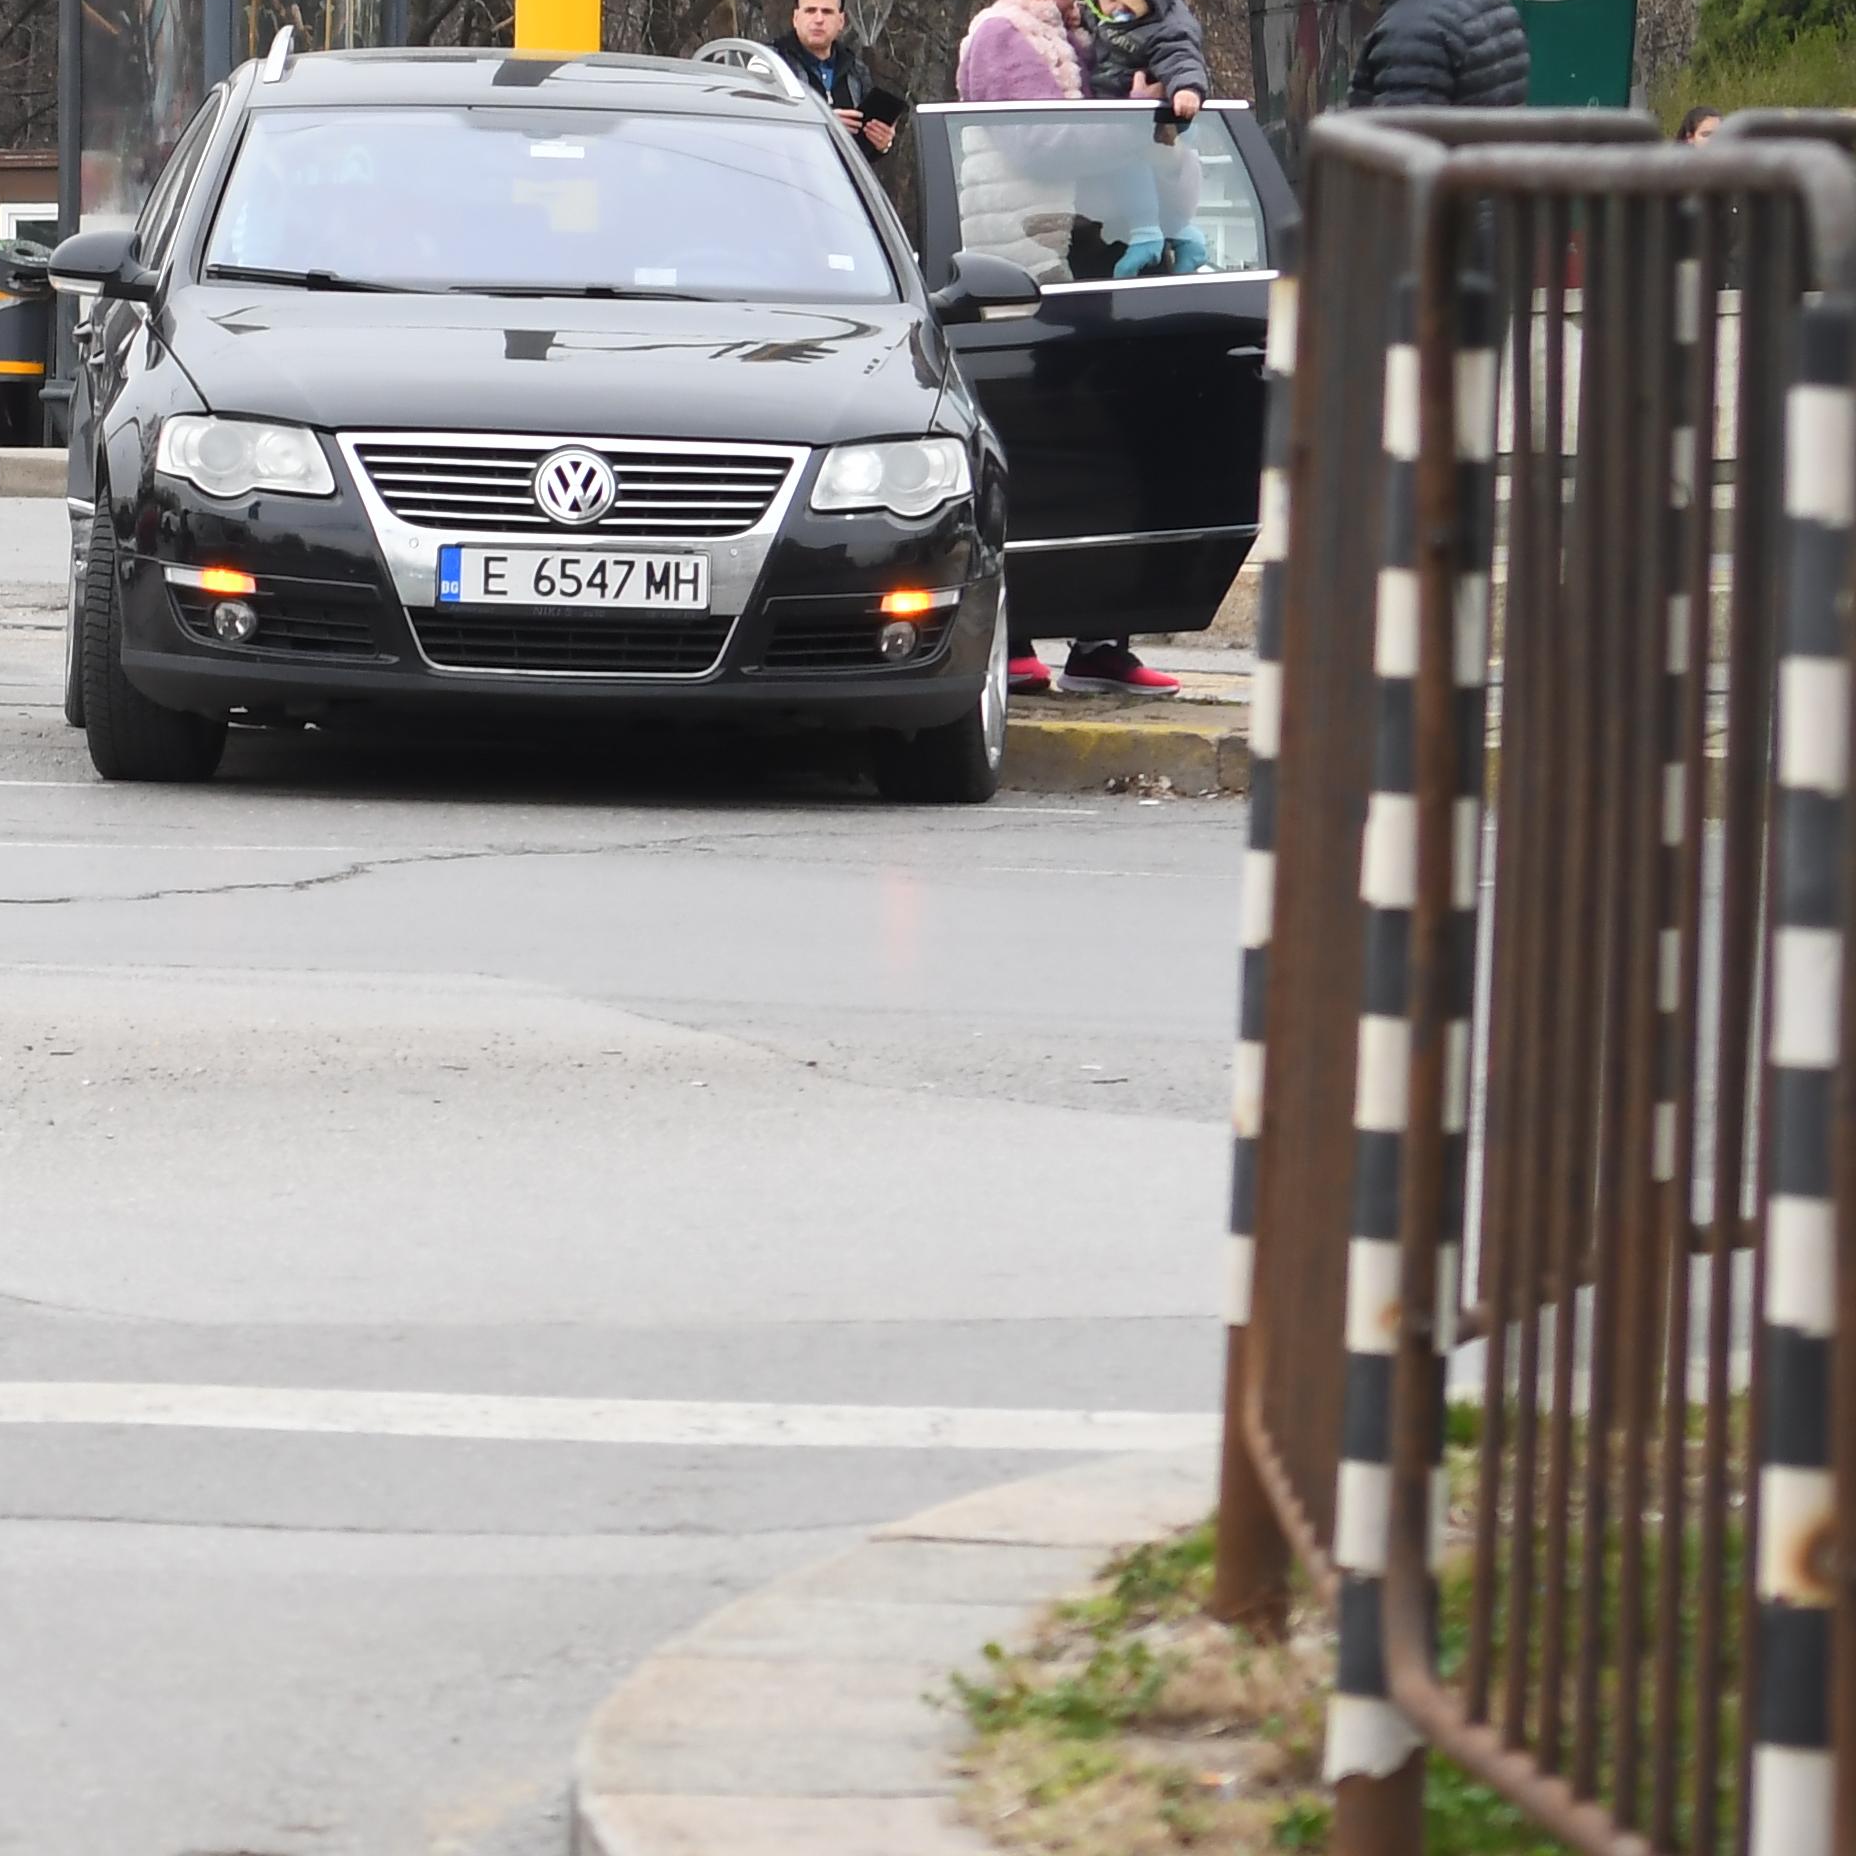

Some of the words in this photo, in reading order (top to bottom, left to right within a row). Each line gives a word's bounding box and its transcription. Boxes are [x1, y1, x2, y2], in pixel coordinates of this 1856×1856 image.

[441, 580, 459, 593] BG
[483, 556, 508, 595] E
[534, 557, 635, 599] 6547
[645, 561, 700, 601] MH
